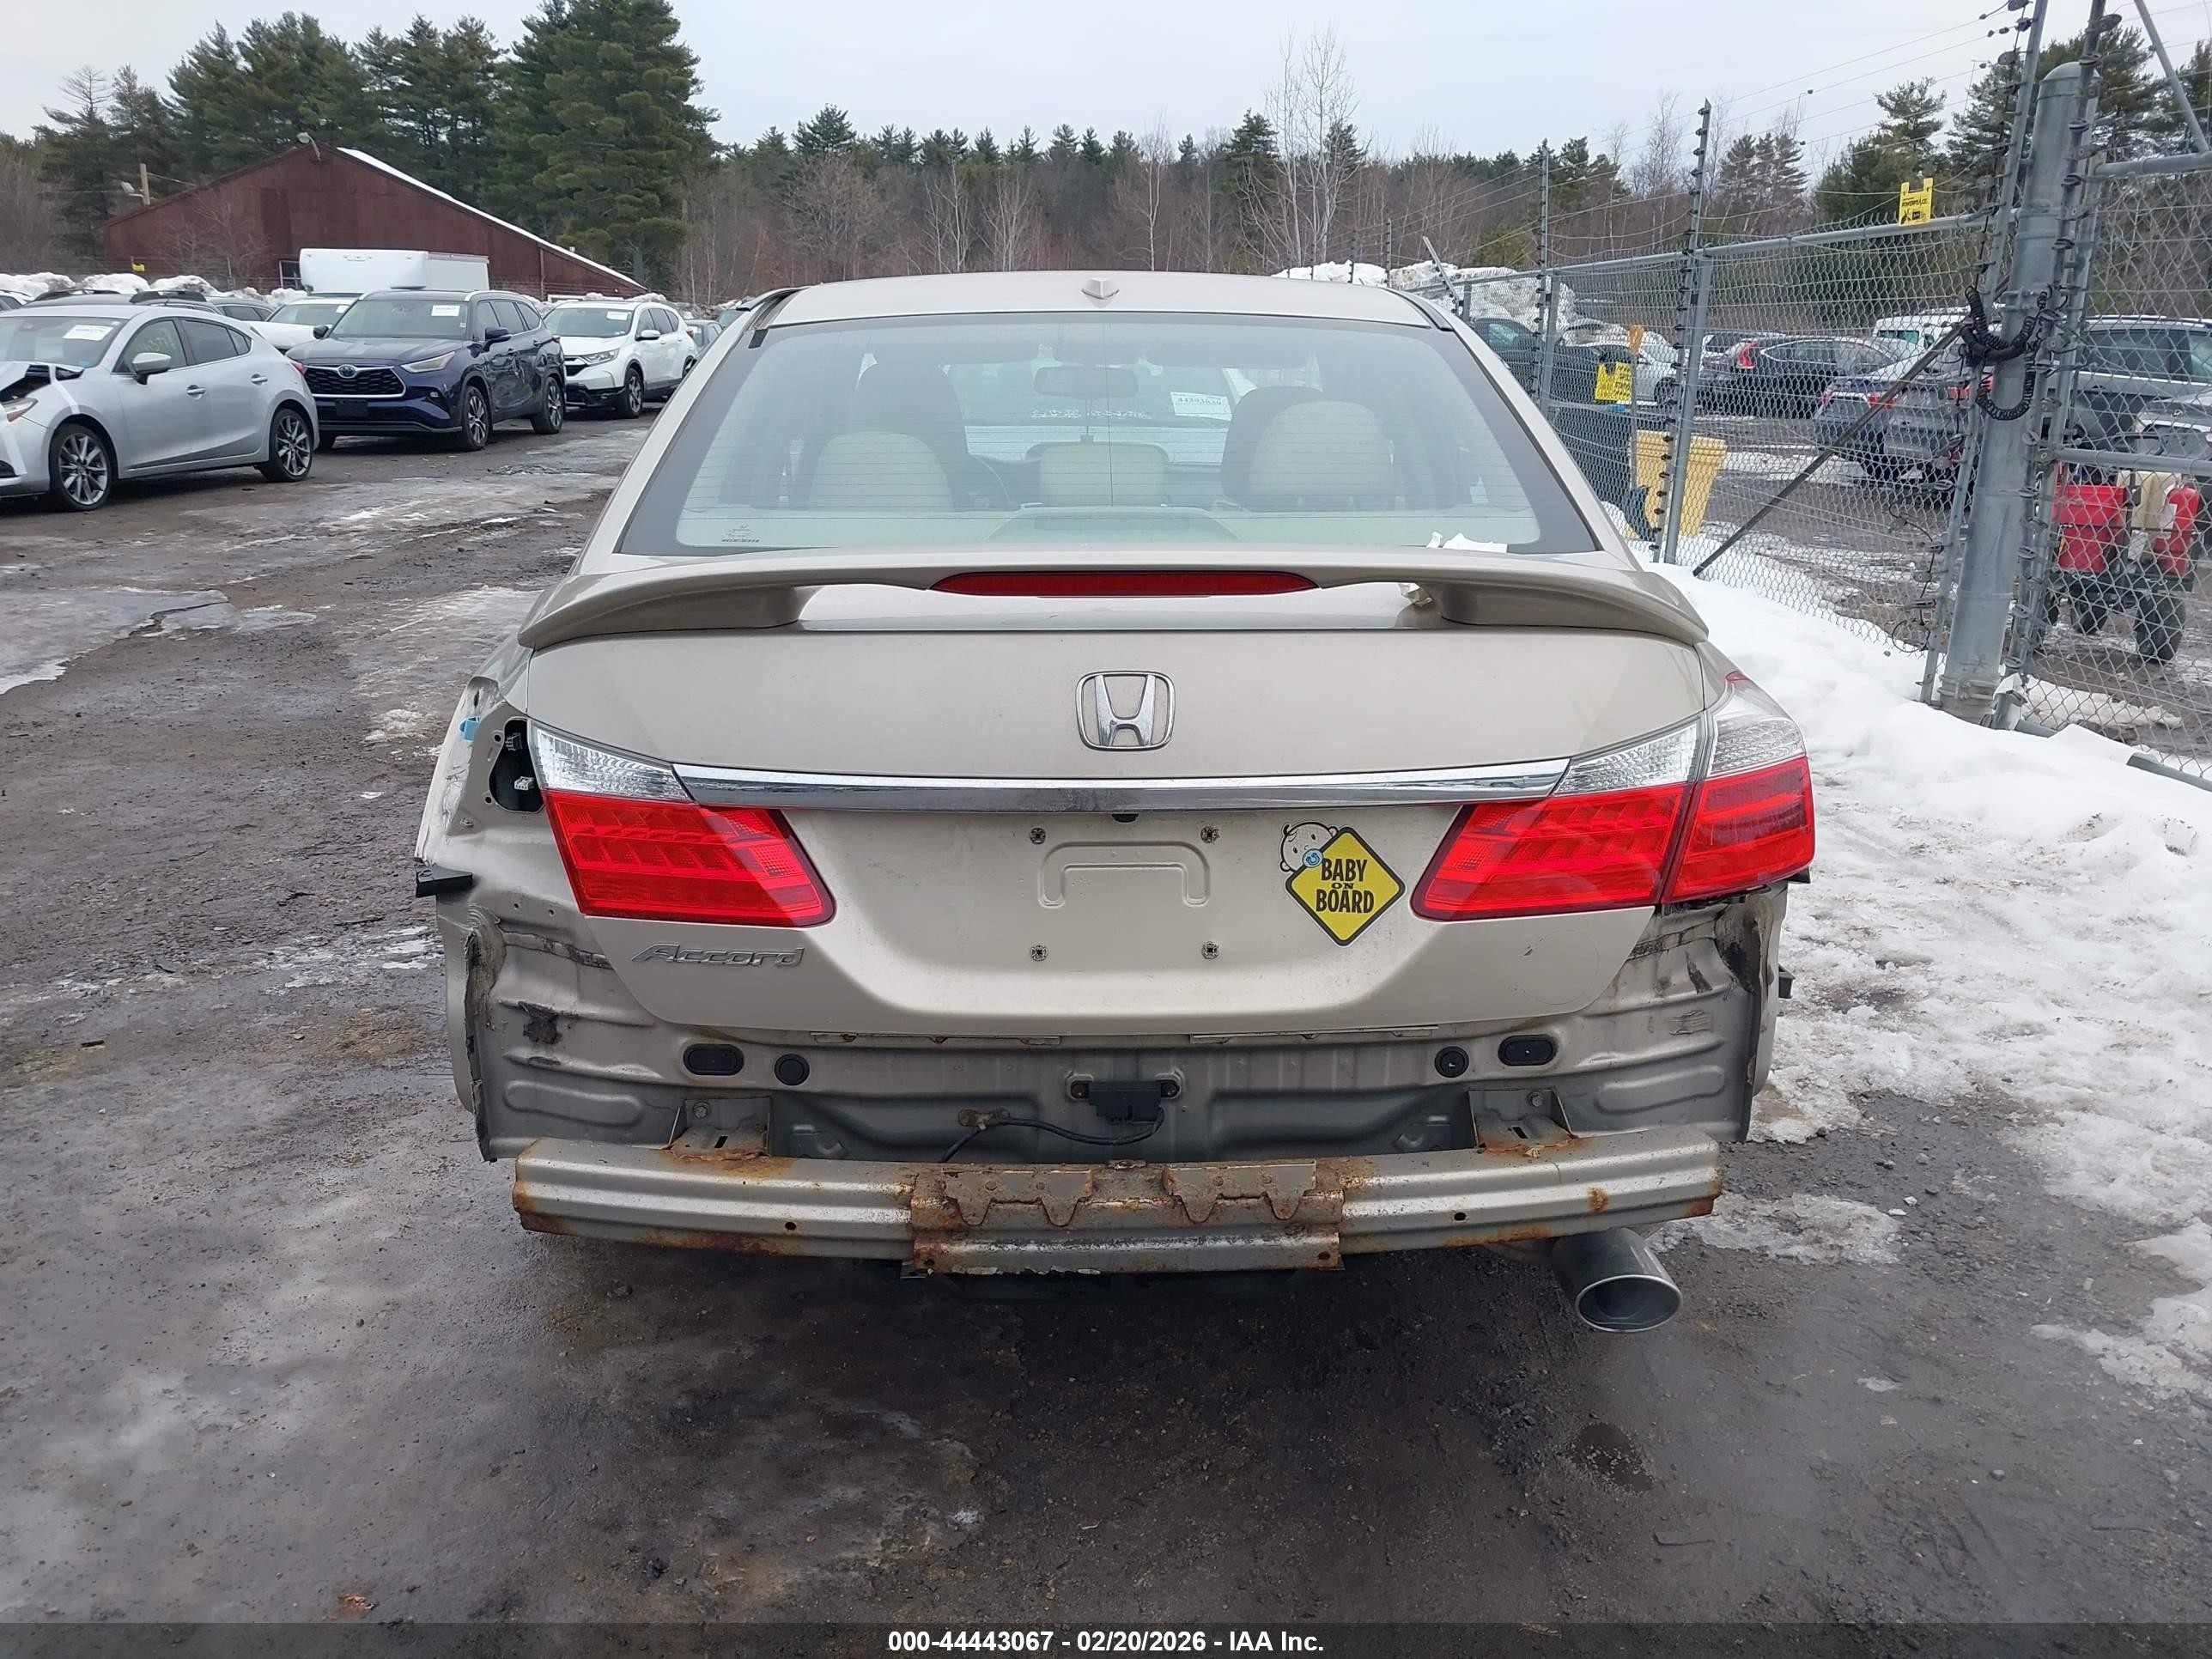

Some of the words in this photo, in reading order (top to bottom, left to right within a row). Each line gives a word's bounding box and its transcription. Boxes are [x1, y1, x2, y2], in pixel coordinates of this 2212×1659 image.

[1322, 859, 1368, 882] BABY
[1316, 889, 1374, 914] BOARD
[631, 943, 805, 968] Accord
